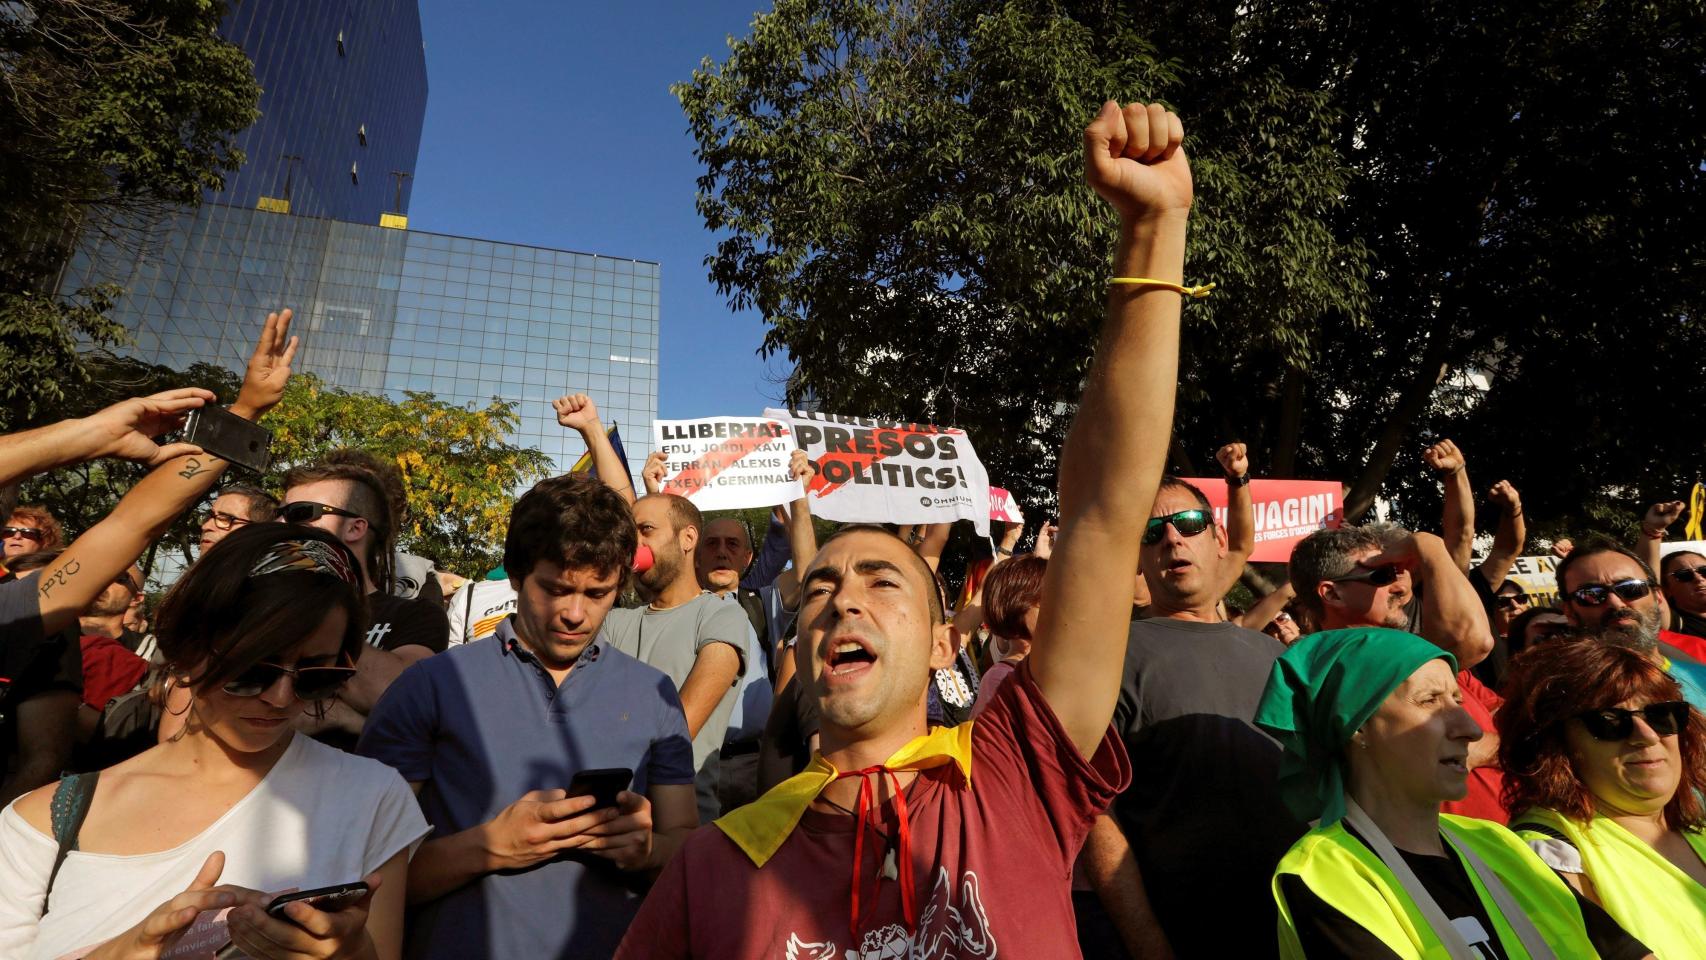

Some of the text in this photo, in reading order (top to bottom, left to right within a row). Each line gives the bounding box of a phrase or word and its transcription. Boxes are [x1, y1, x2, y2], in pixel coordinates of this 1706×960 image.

[662, 422, 784, 440] LLIBERTAT
[662, 444, 696, 455] EDU,
[753, 442, 786, 452] XAVI
[794, 425, 958, 460] PRESOS
[731, 458, 781, 469] ALEXIS
[717, 474, 794, 486] GERMINAL
[1253, 493, 1334, 531] VAGIN!
